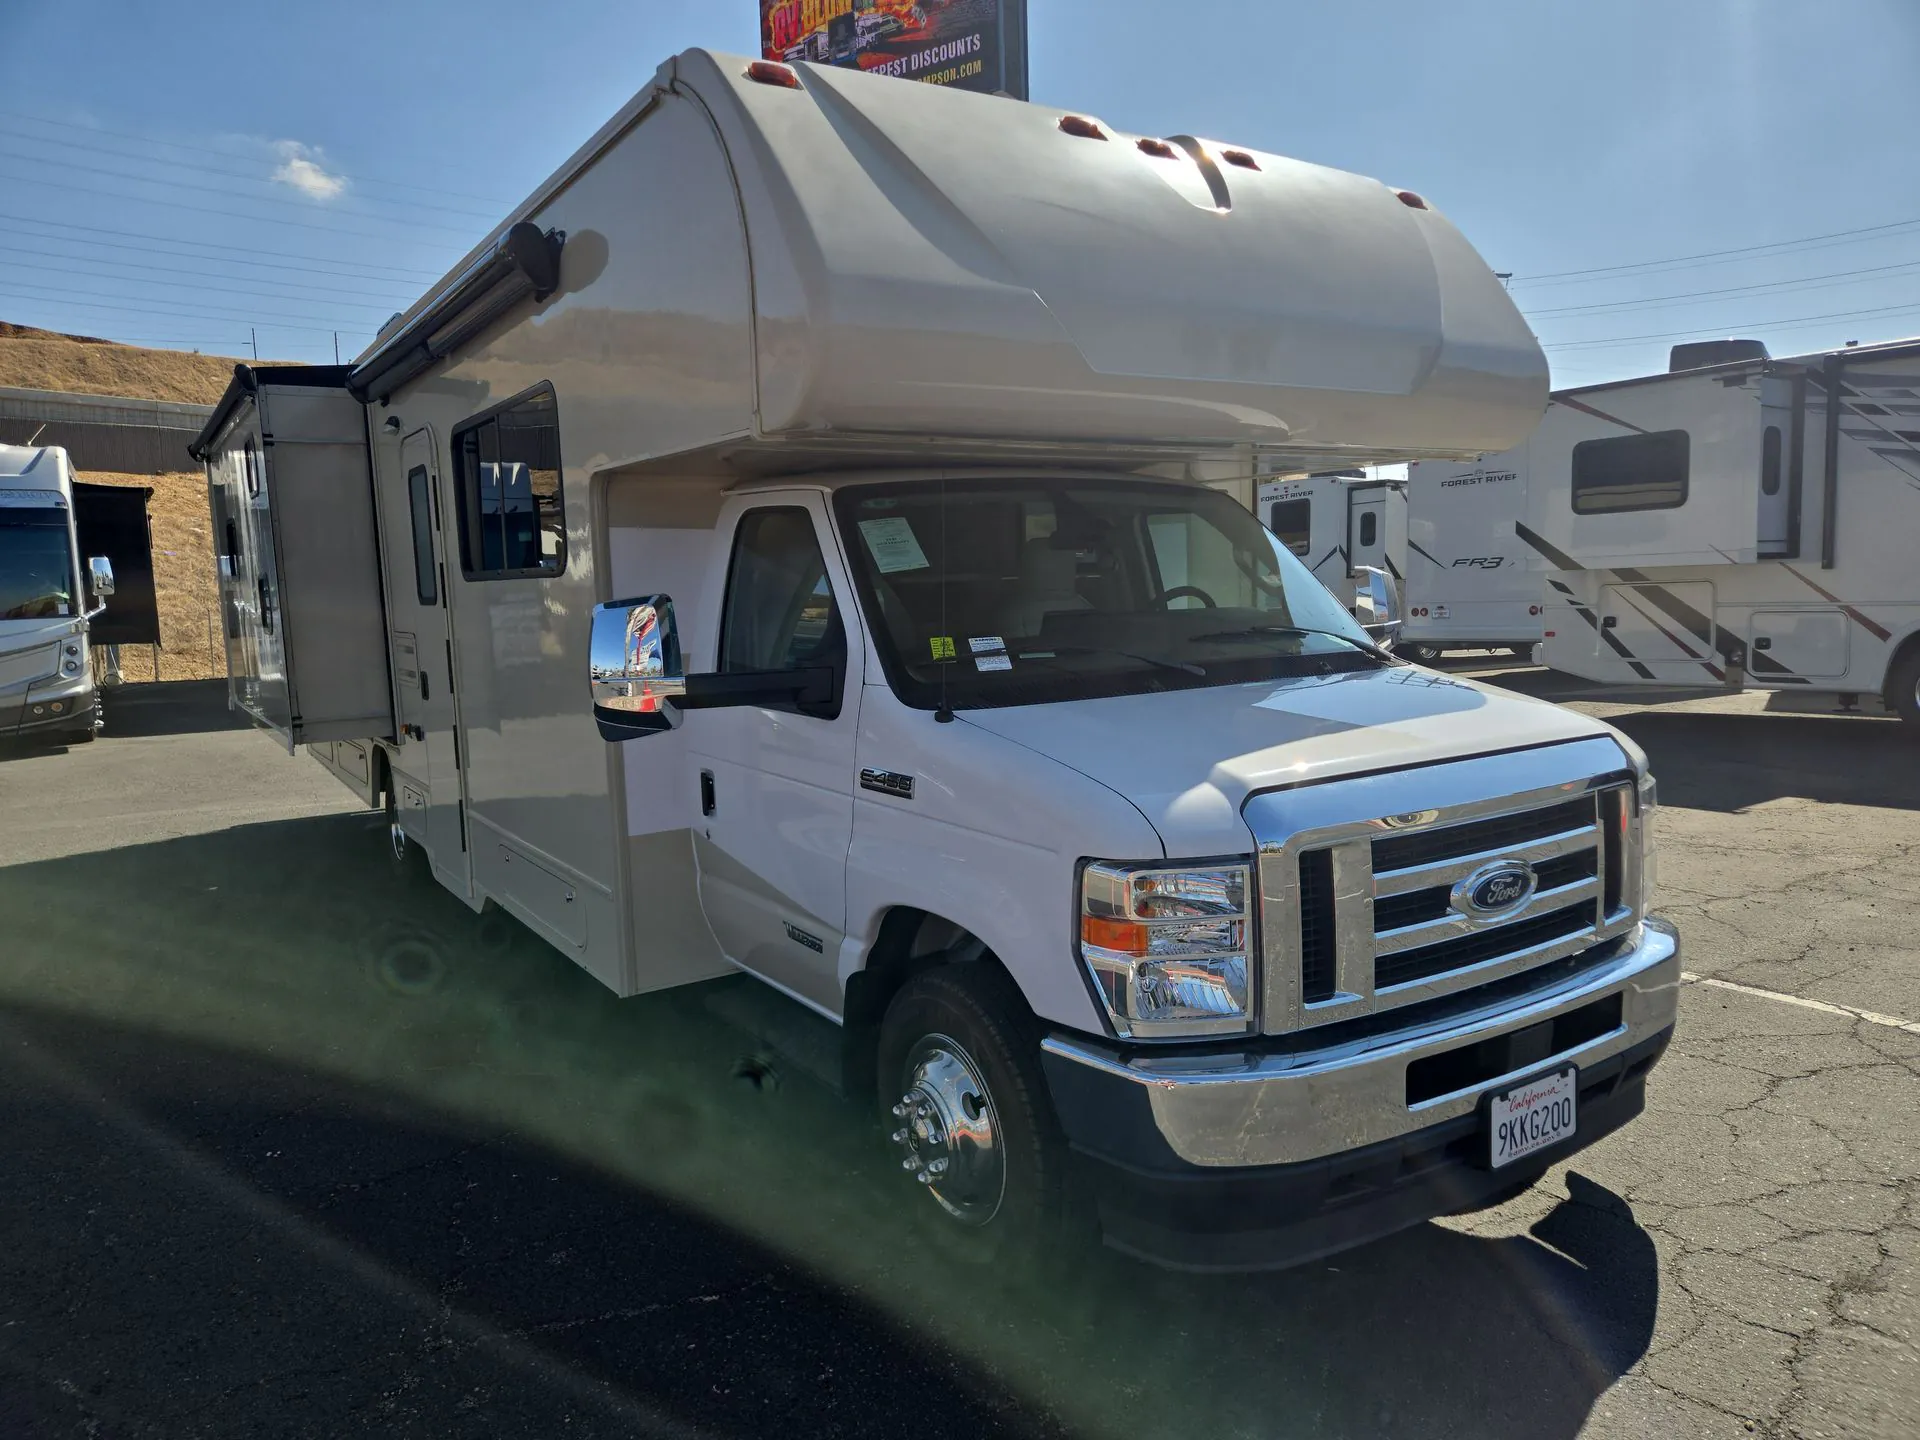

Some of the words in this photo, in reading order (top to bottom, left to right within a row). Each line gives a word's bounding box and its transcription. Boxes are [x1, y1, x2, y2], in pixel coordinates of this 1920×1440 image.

[774, 0, 799, 50] RV
[866, 57, 908, 77] EPEST
[911, 34, 981, 71] DISCOUNTS
[1441, 477, 1483, 487] FOREST
[1260, 493, 1289, 502] FOREST
[1290, 490, 1313, 498] RIVER
[1452, 557, 1504, 569] FR3
[1487, 876, 1522, 903] Ford
[1509, 1086, 1561, 1112] California
[1499, 1097, 1571, 1156] 9KKG200
